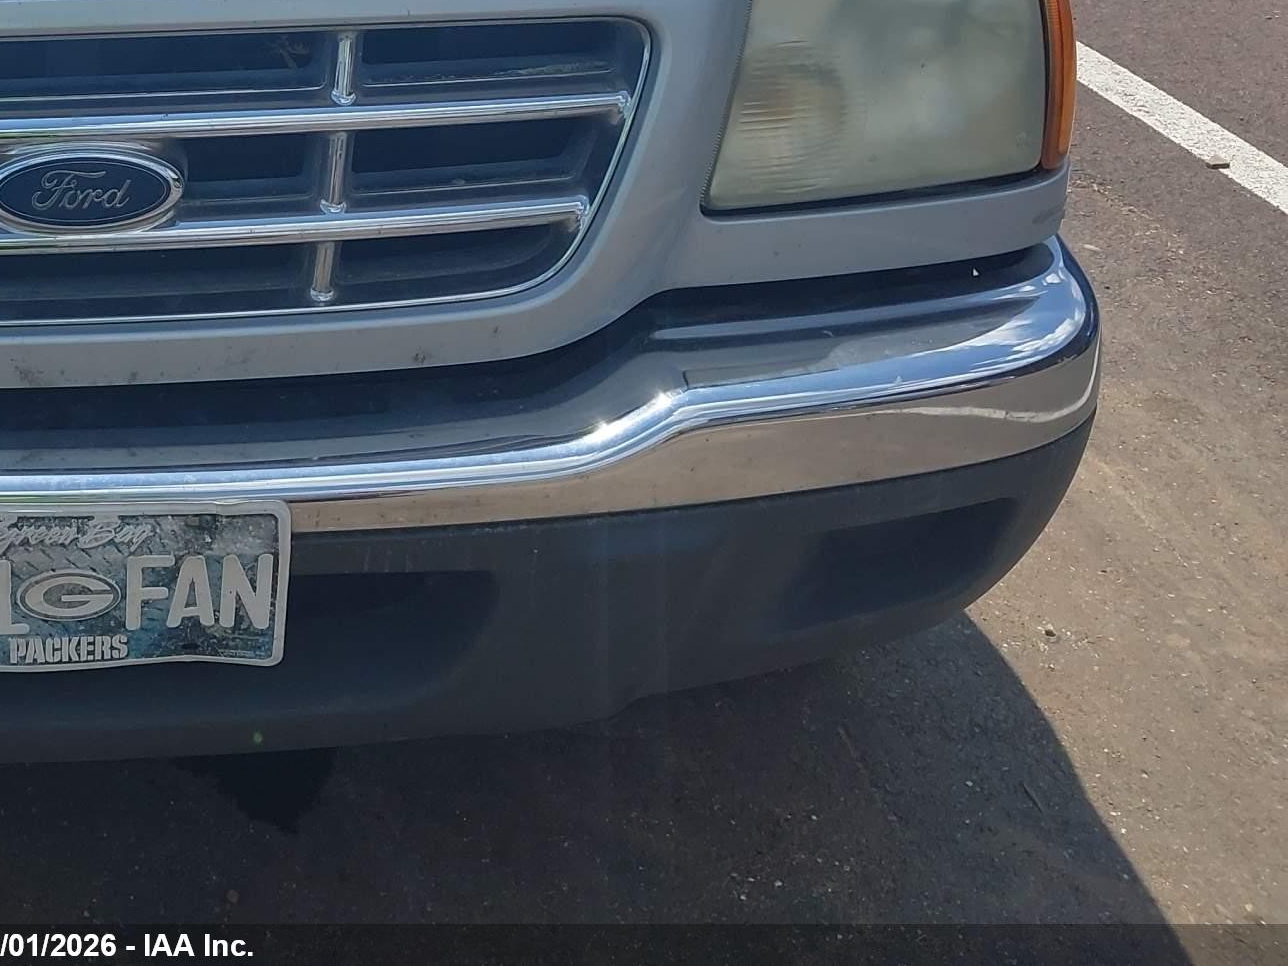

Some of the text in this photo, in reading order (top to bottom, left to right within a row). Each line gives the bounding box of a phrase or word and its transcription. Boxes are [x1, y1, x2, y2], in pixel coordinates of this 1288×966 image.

[31, 170, 132, 211] Ford
[77, 515, 154, 553] Bay
[124, 553, 274, 631] FAN
[10, 634, 129, 664] PACKERS
